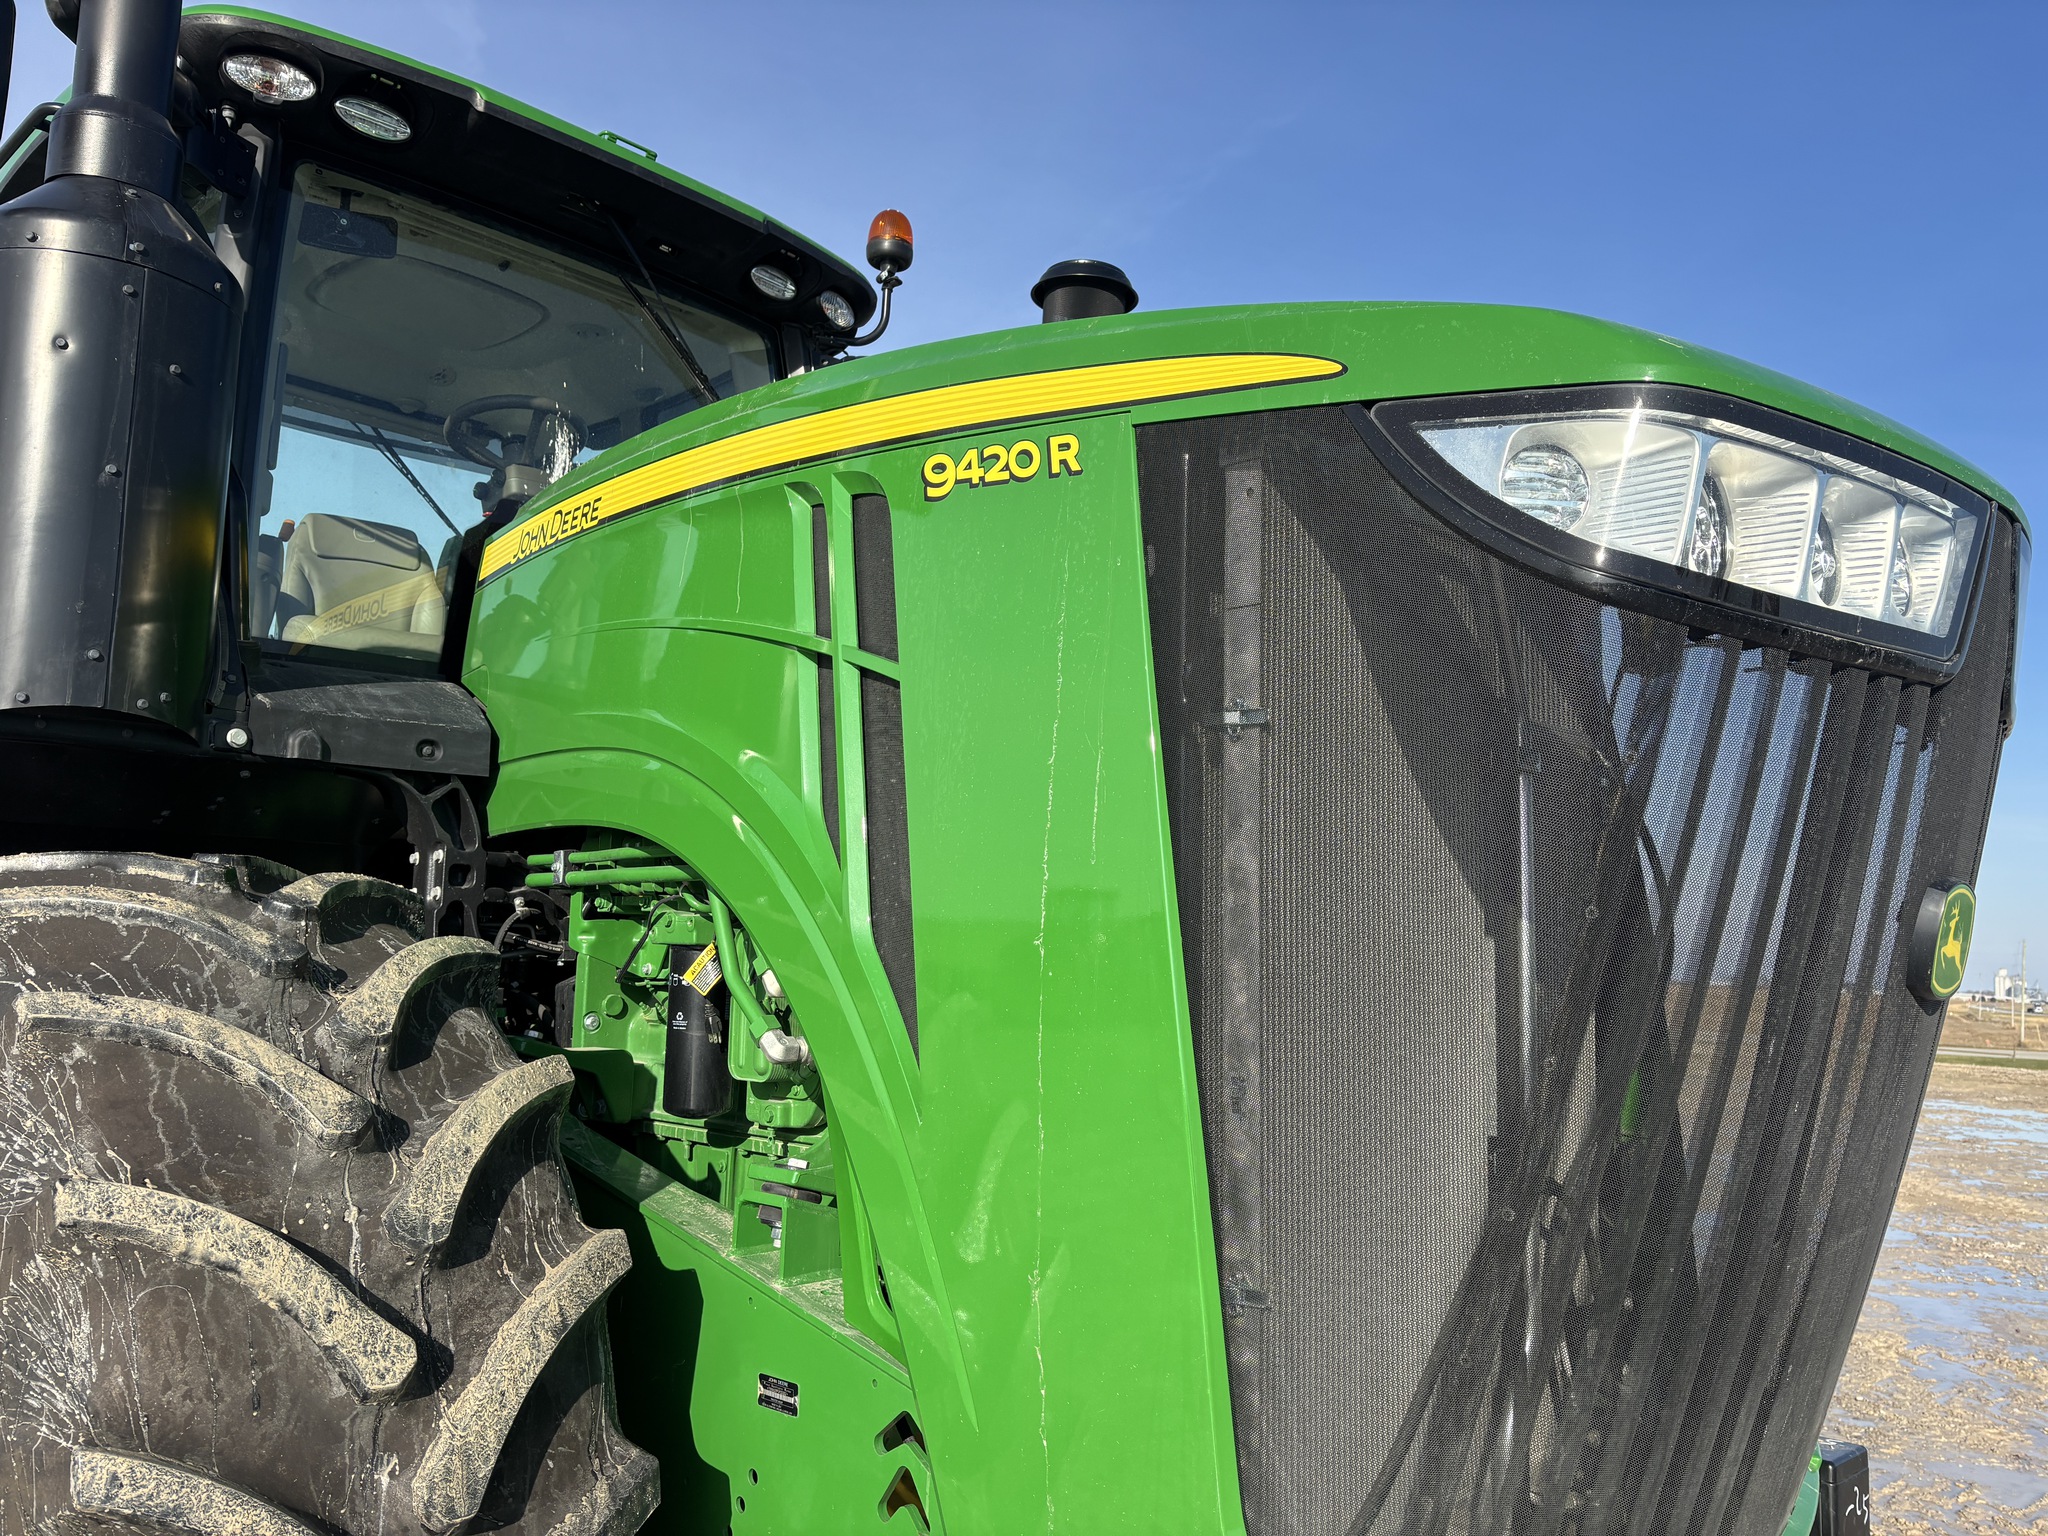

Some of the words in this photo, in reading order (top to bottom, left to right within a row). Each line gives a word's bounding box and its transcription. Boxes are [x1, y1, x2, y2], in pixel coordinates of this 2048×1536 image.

[921, 440, 1041, 502] 9420
[1047, 433, 1083, 479] R
[512, 520, 550, 560] JOHN
[550, 496, 602, 537] DEERE
[692, 946, 715, 972] CAUTION
